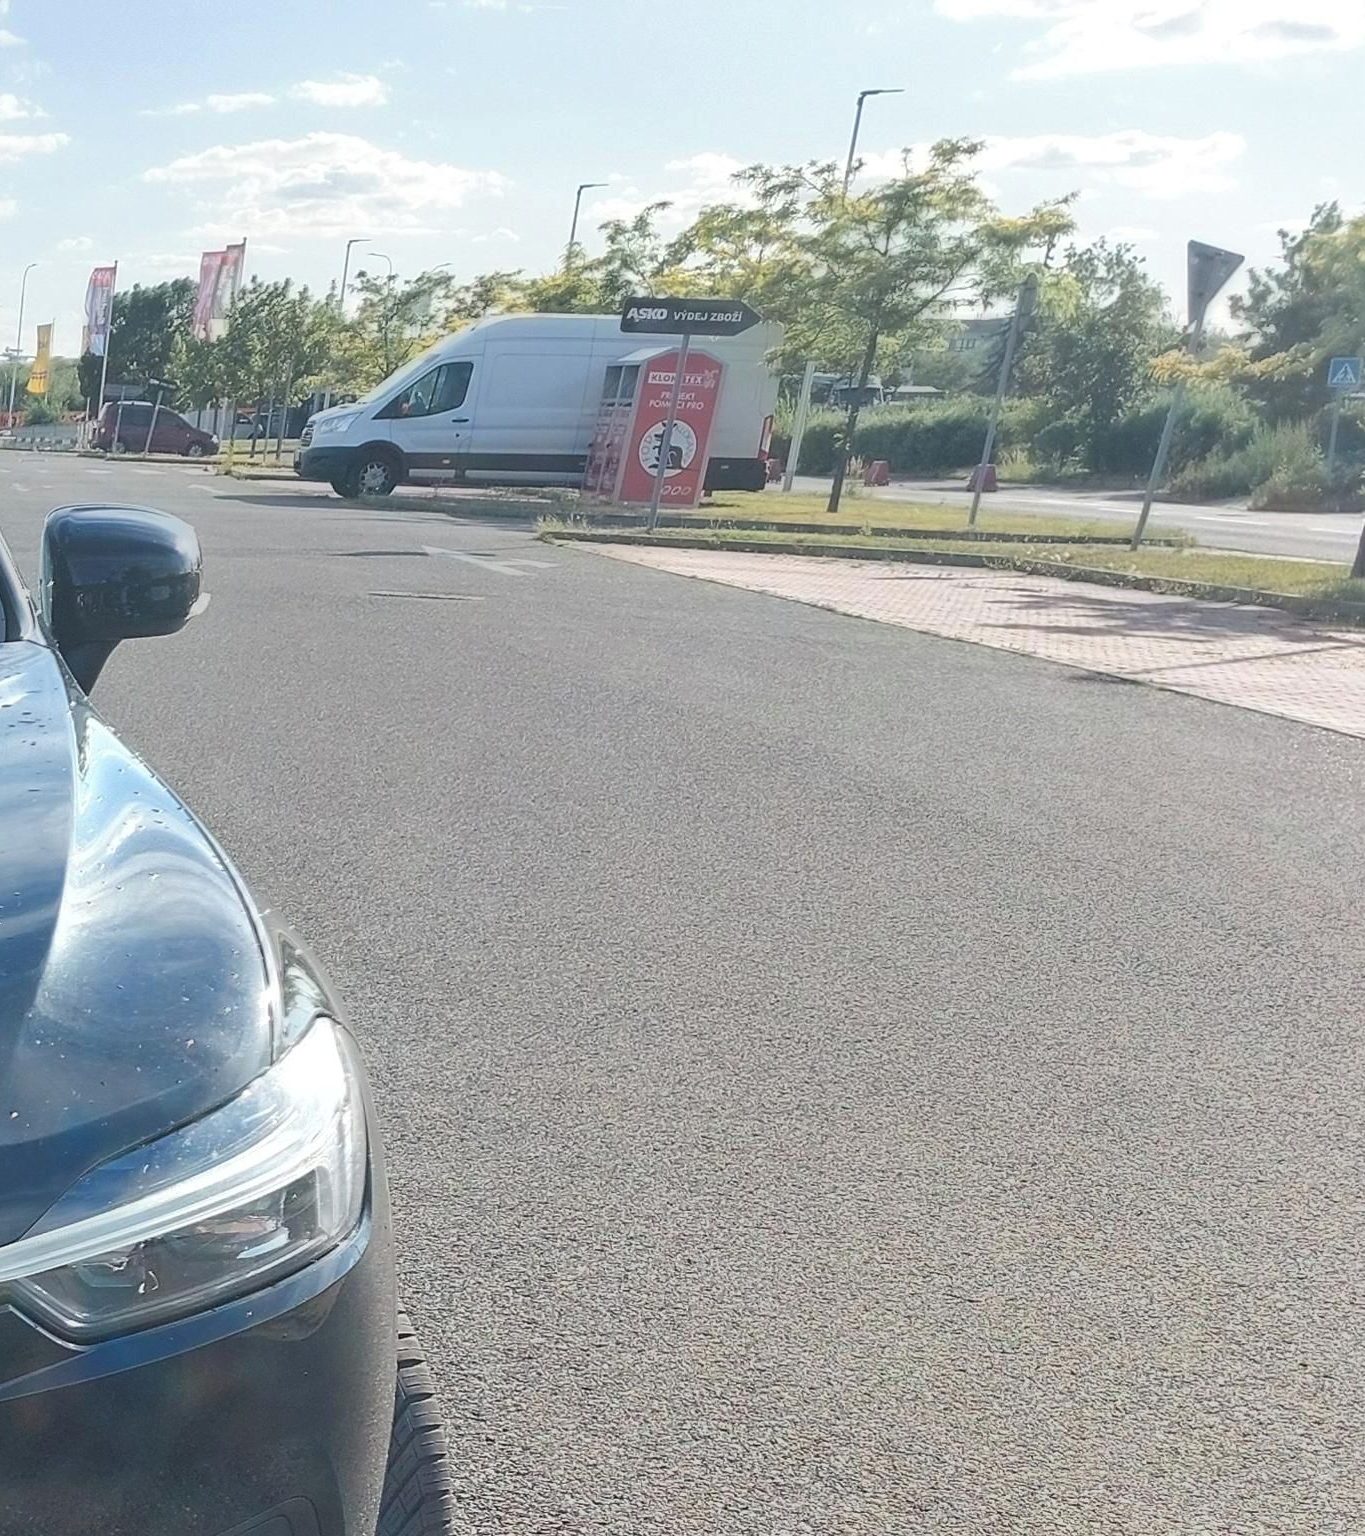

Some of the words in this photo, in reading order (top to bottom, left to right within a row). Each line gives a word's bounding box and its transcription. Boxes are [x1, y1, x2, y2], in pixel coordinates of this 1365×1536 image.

[626, 307, 668, 322] ASKO
[674, 309, 708, 321] VÝDEJ
[709, 310, 743, 322] ZBOŽÍ
